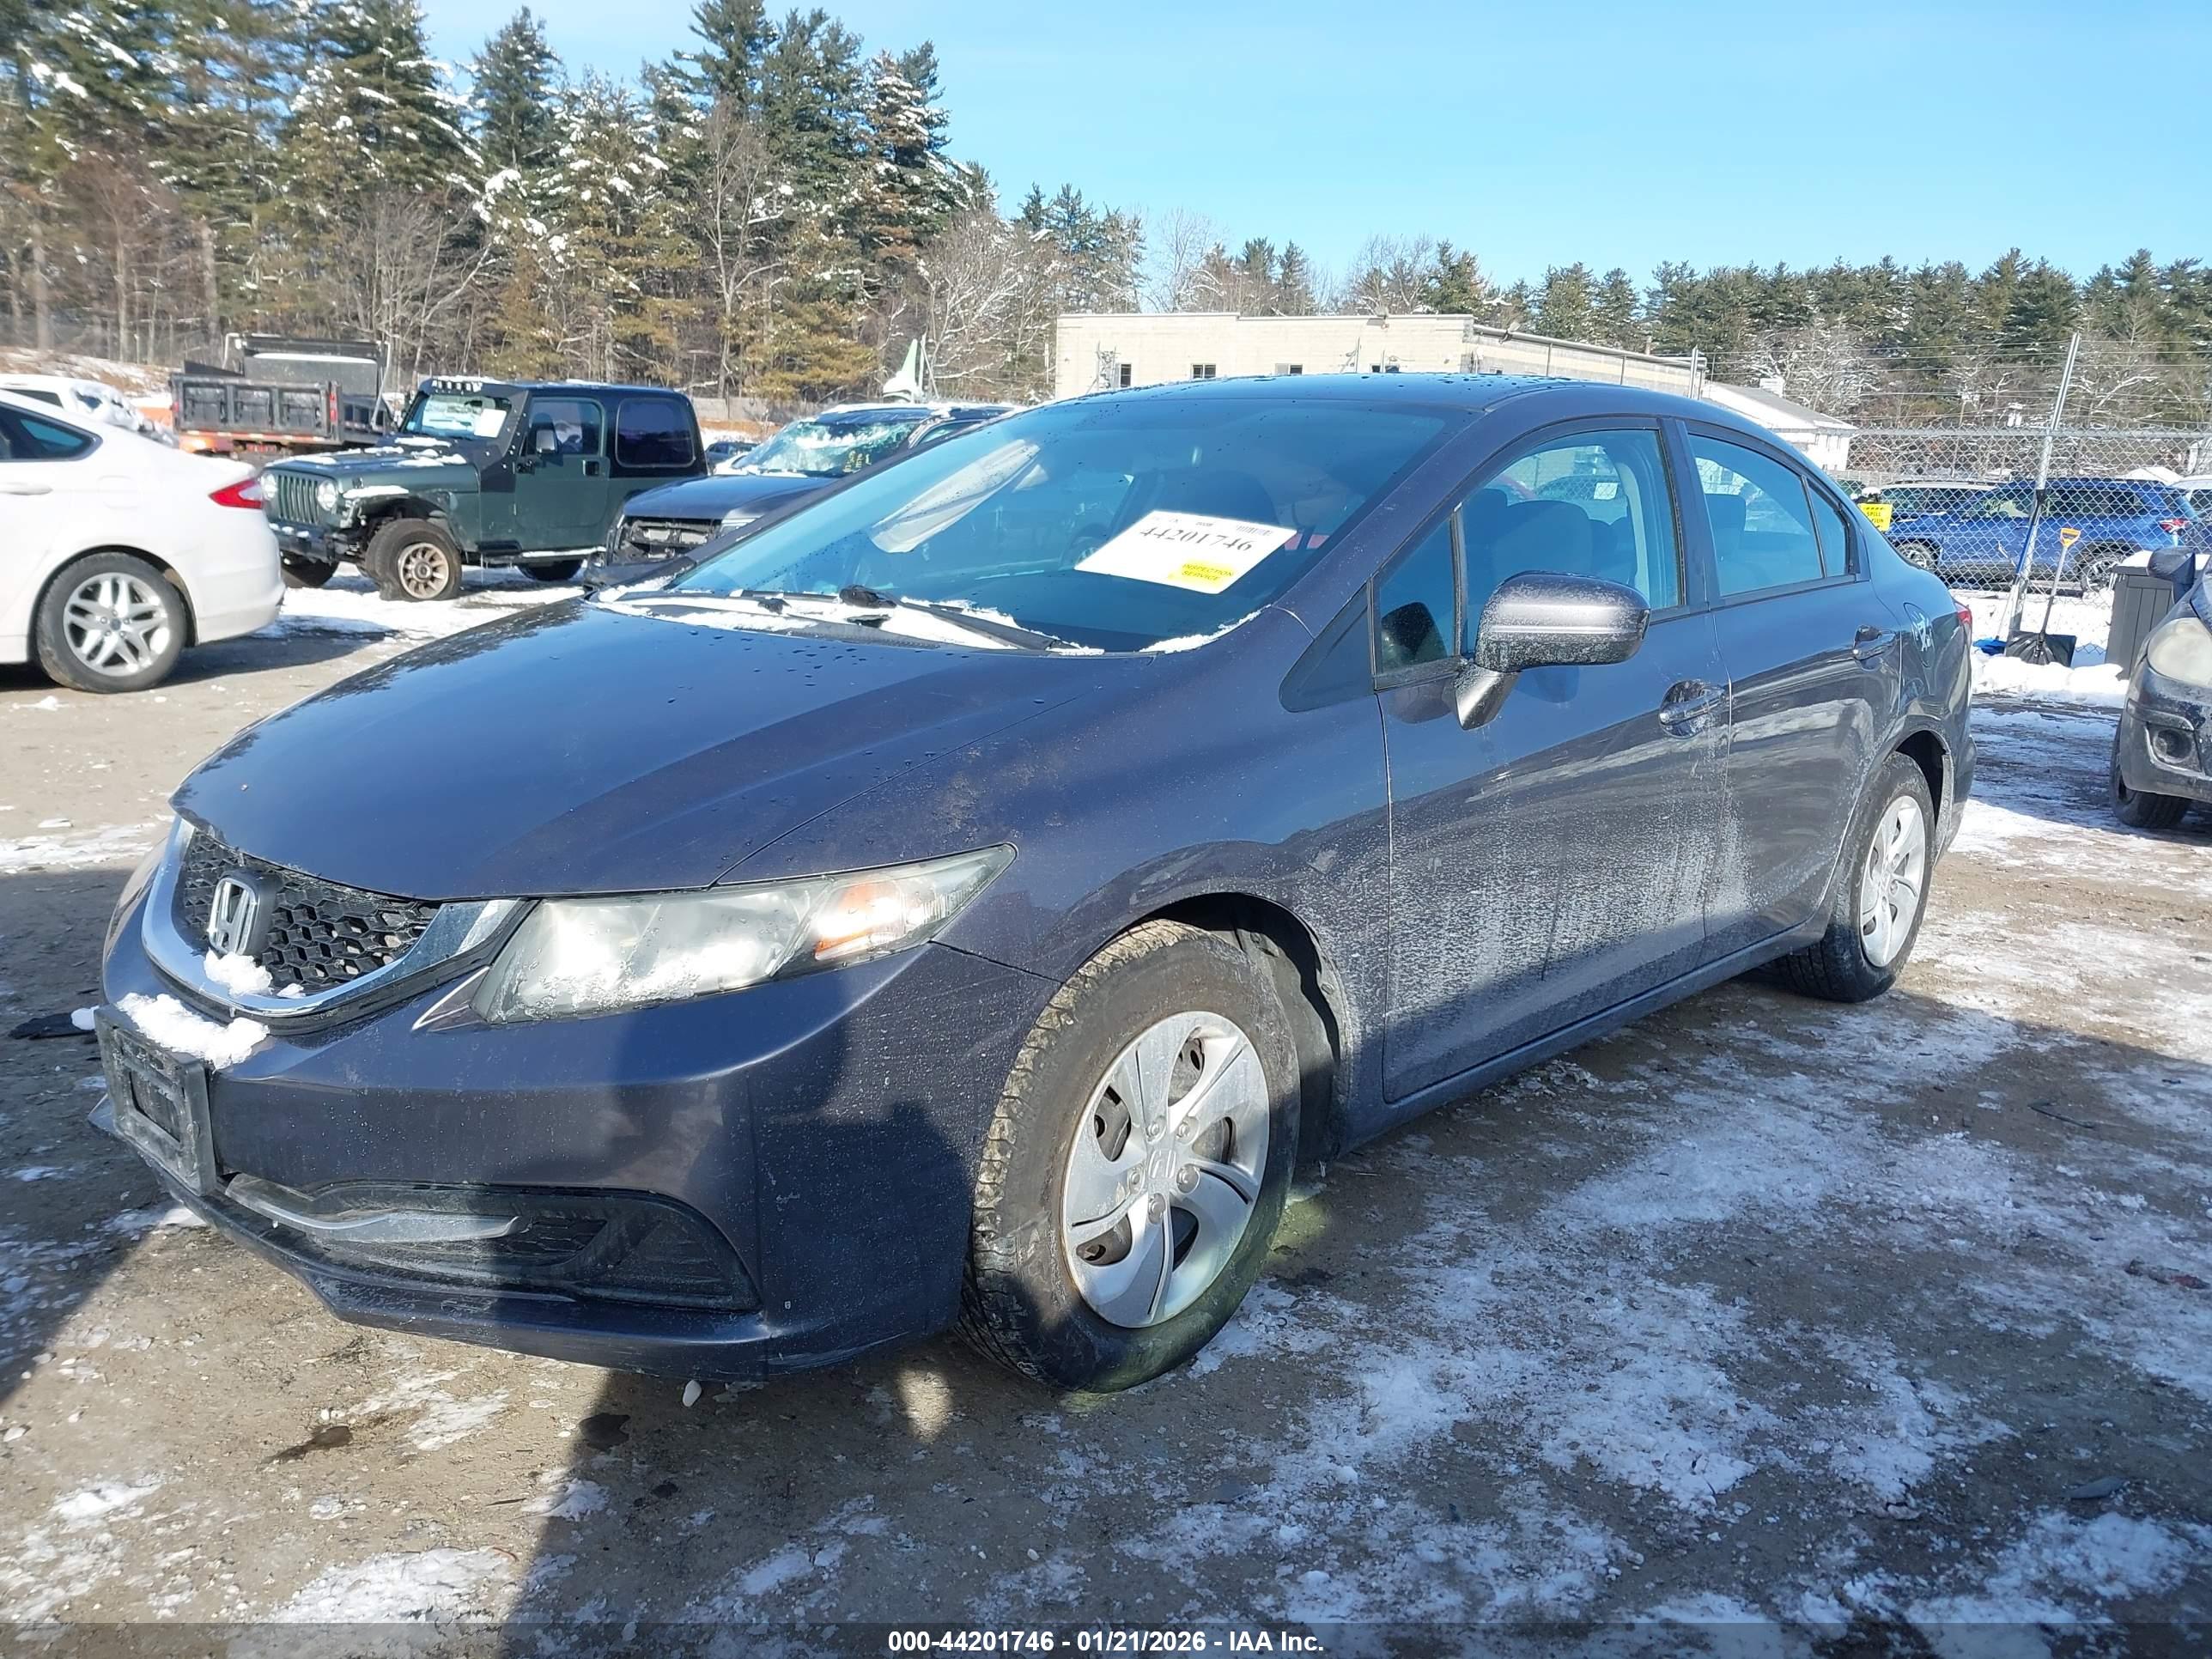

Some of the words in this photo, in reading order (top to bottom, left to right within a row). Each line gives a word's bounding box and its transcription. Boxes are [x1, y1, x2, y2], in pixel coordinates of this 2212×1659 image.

[1139, 526, 1256, 551] 44201746
[1182, 563, 1233, 576] INSPECTION
[1182, 570, 1221, 581] SERVICE
